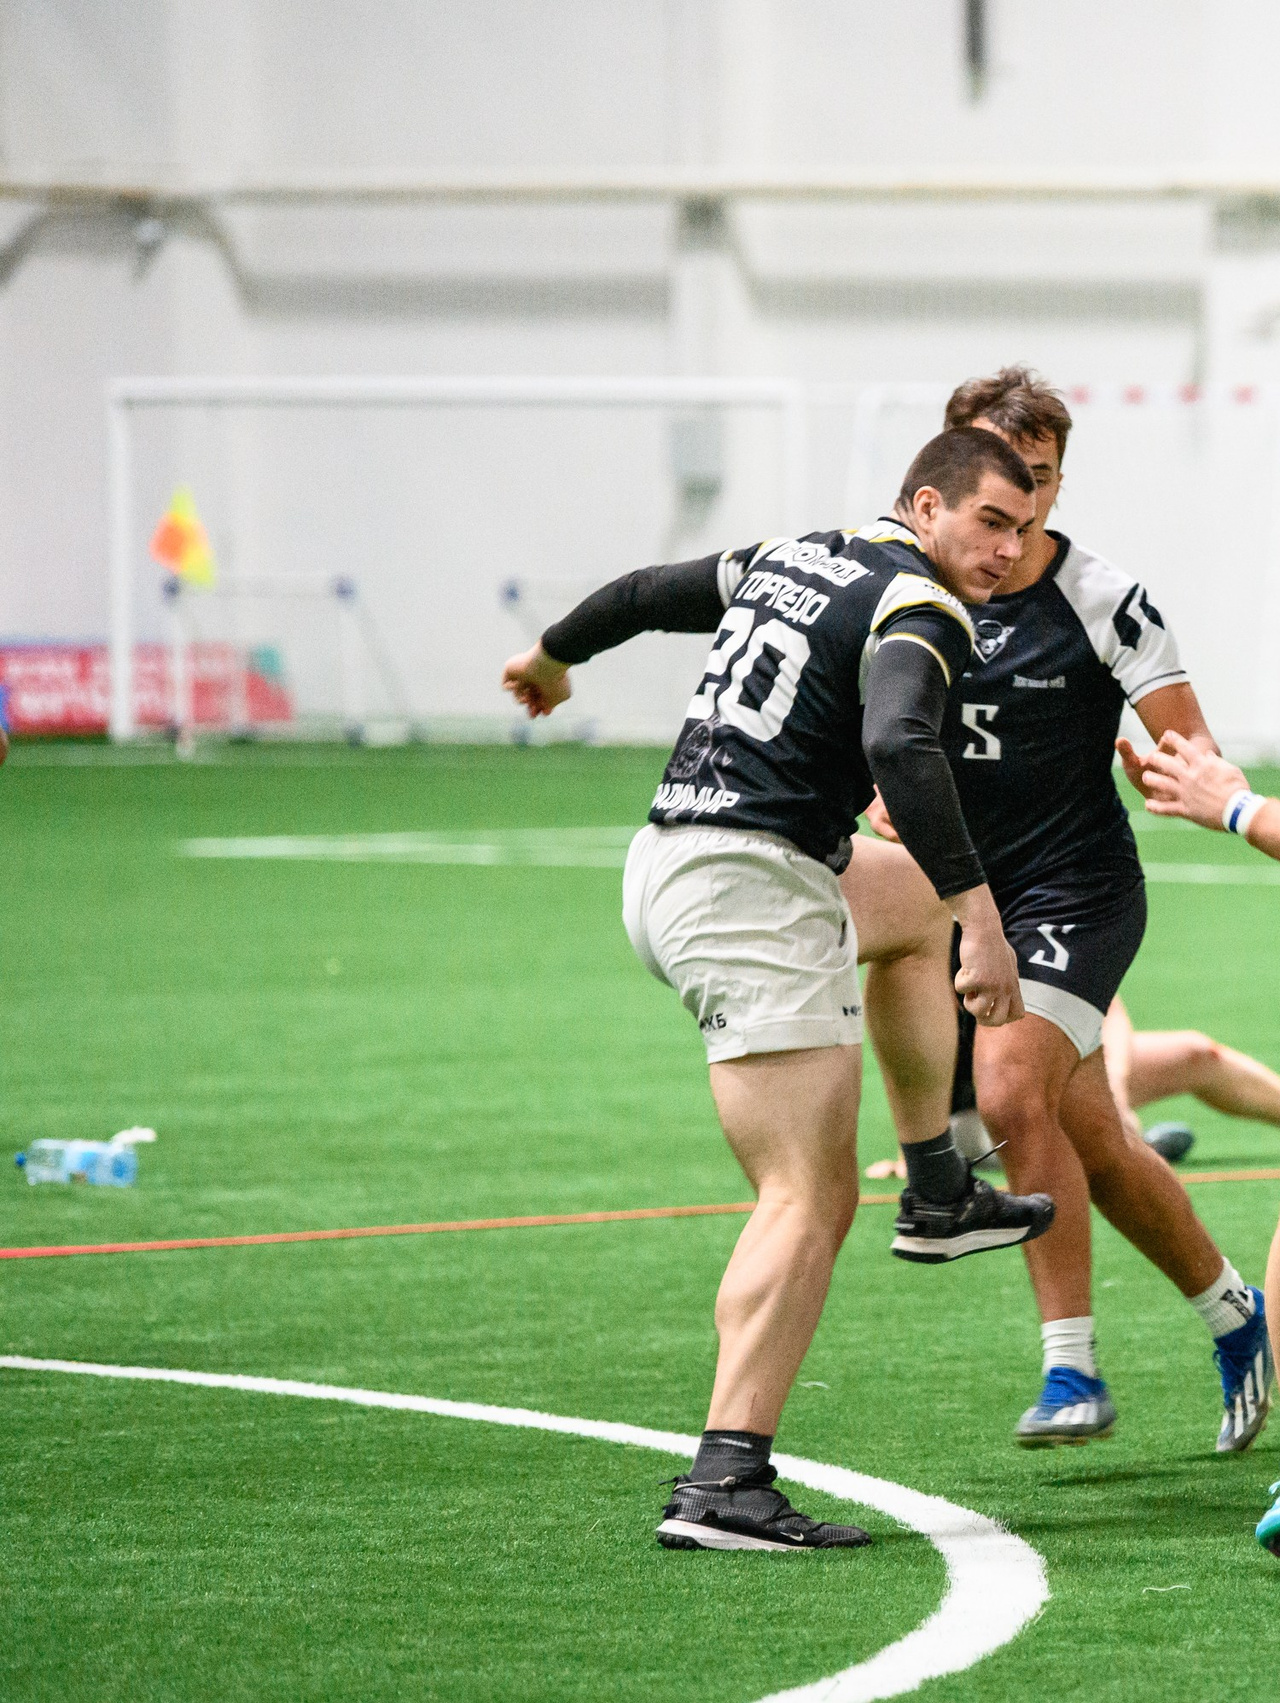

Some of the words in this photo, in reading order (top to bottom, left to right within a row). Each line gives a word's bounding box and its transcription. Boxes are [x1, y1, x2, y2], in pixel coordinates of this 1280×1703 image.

[735, 571, 831, 626] ТОРПЕДО
[686, 606, 812, 742] 20
[962, 703, 1001, 760] 5
